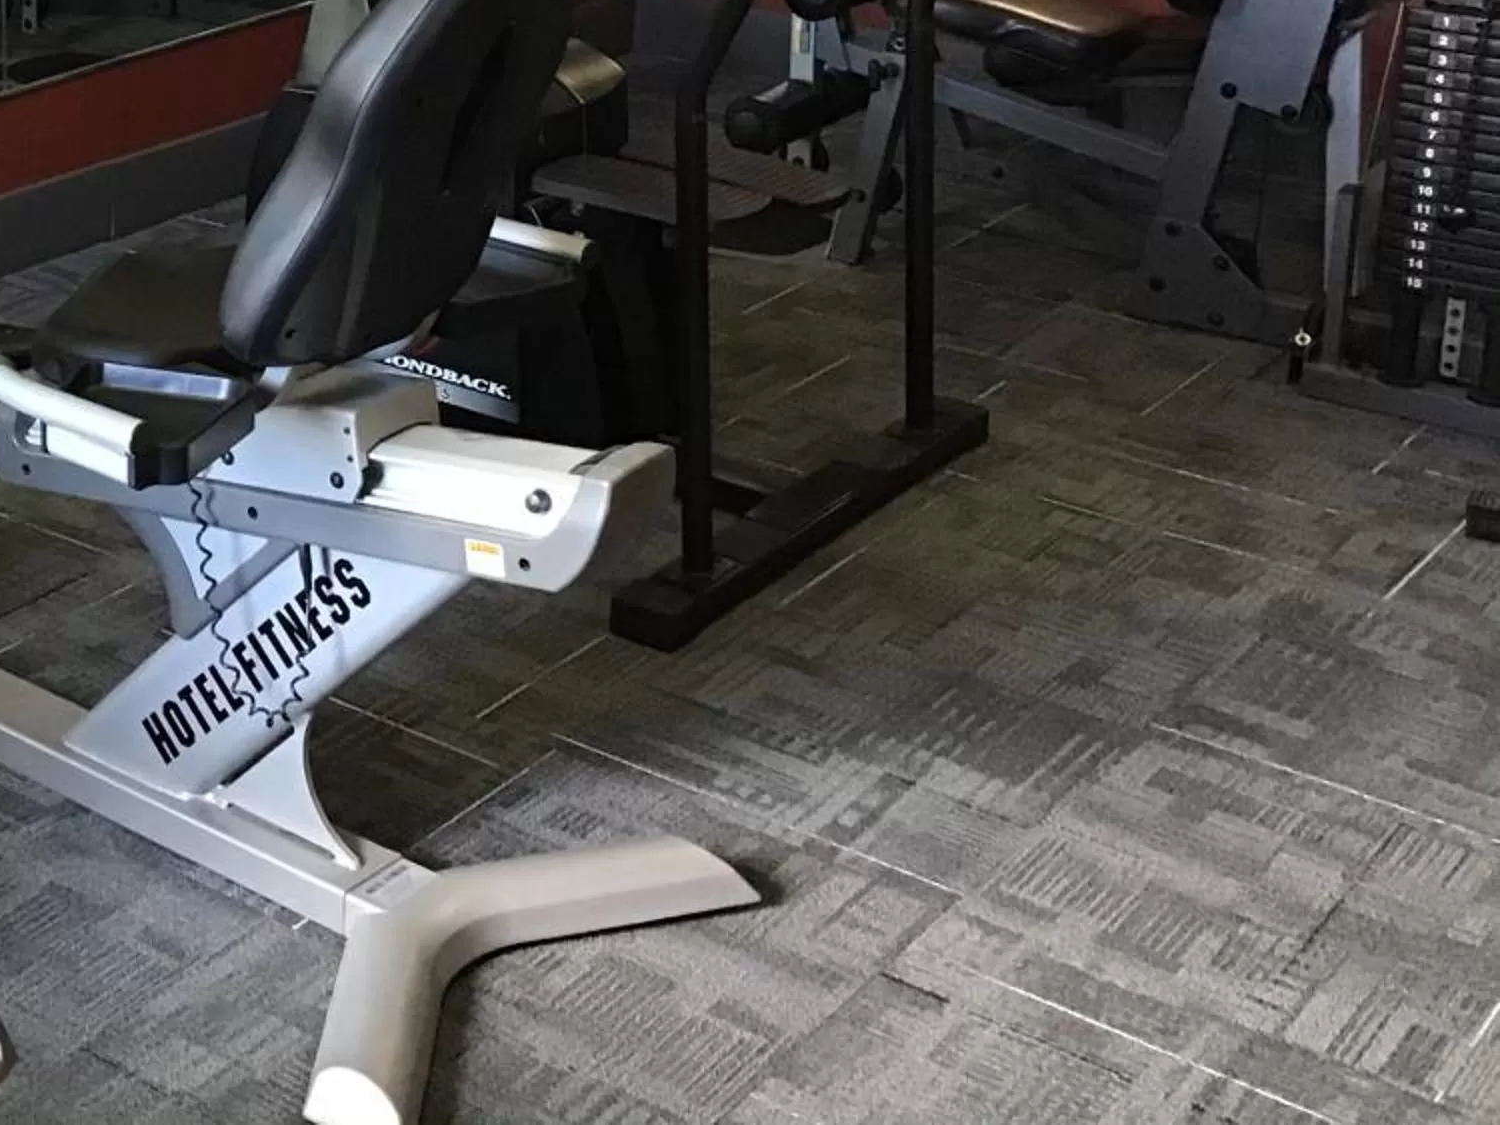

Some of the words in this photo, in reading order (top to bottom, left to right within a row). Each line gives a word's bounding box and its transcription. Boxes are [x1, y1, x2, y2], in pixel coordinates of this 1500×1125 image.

[1418, 184, 1434, 197] 10
[1416, 203, 1431, 215] 11
[1413, 221, 1429, 232] 12
[1411, 239, 1426, 251] 13
[1409, 258, 1424, 269] 14
[1407, 277, 1422, 288] 15
[141, 665, 246, 765] HOTEL
[231, 558, 372, 692] FITNESS
